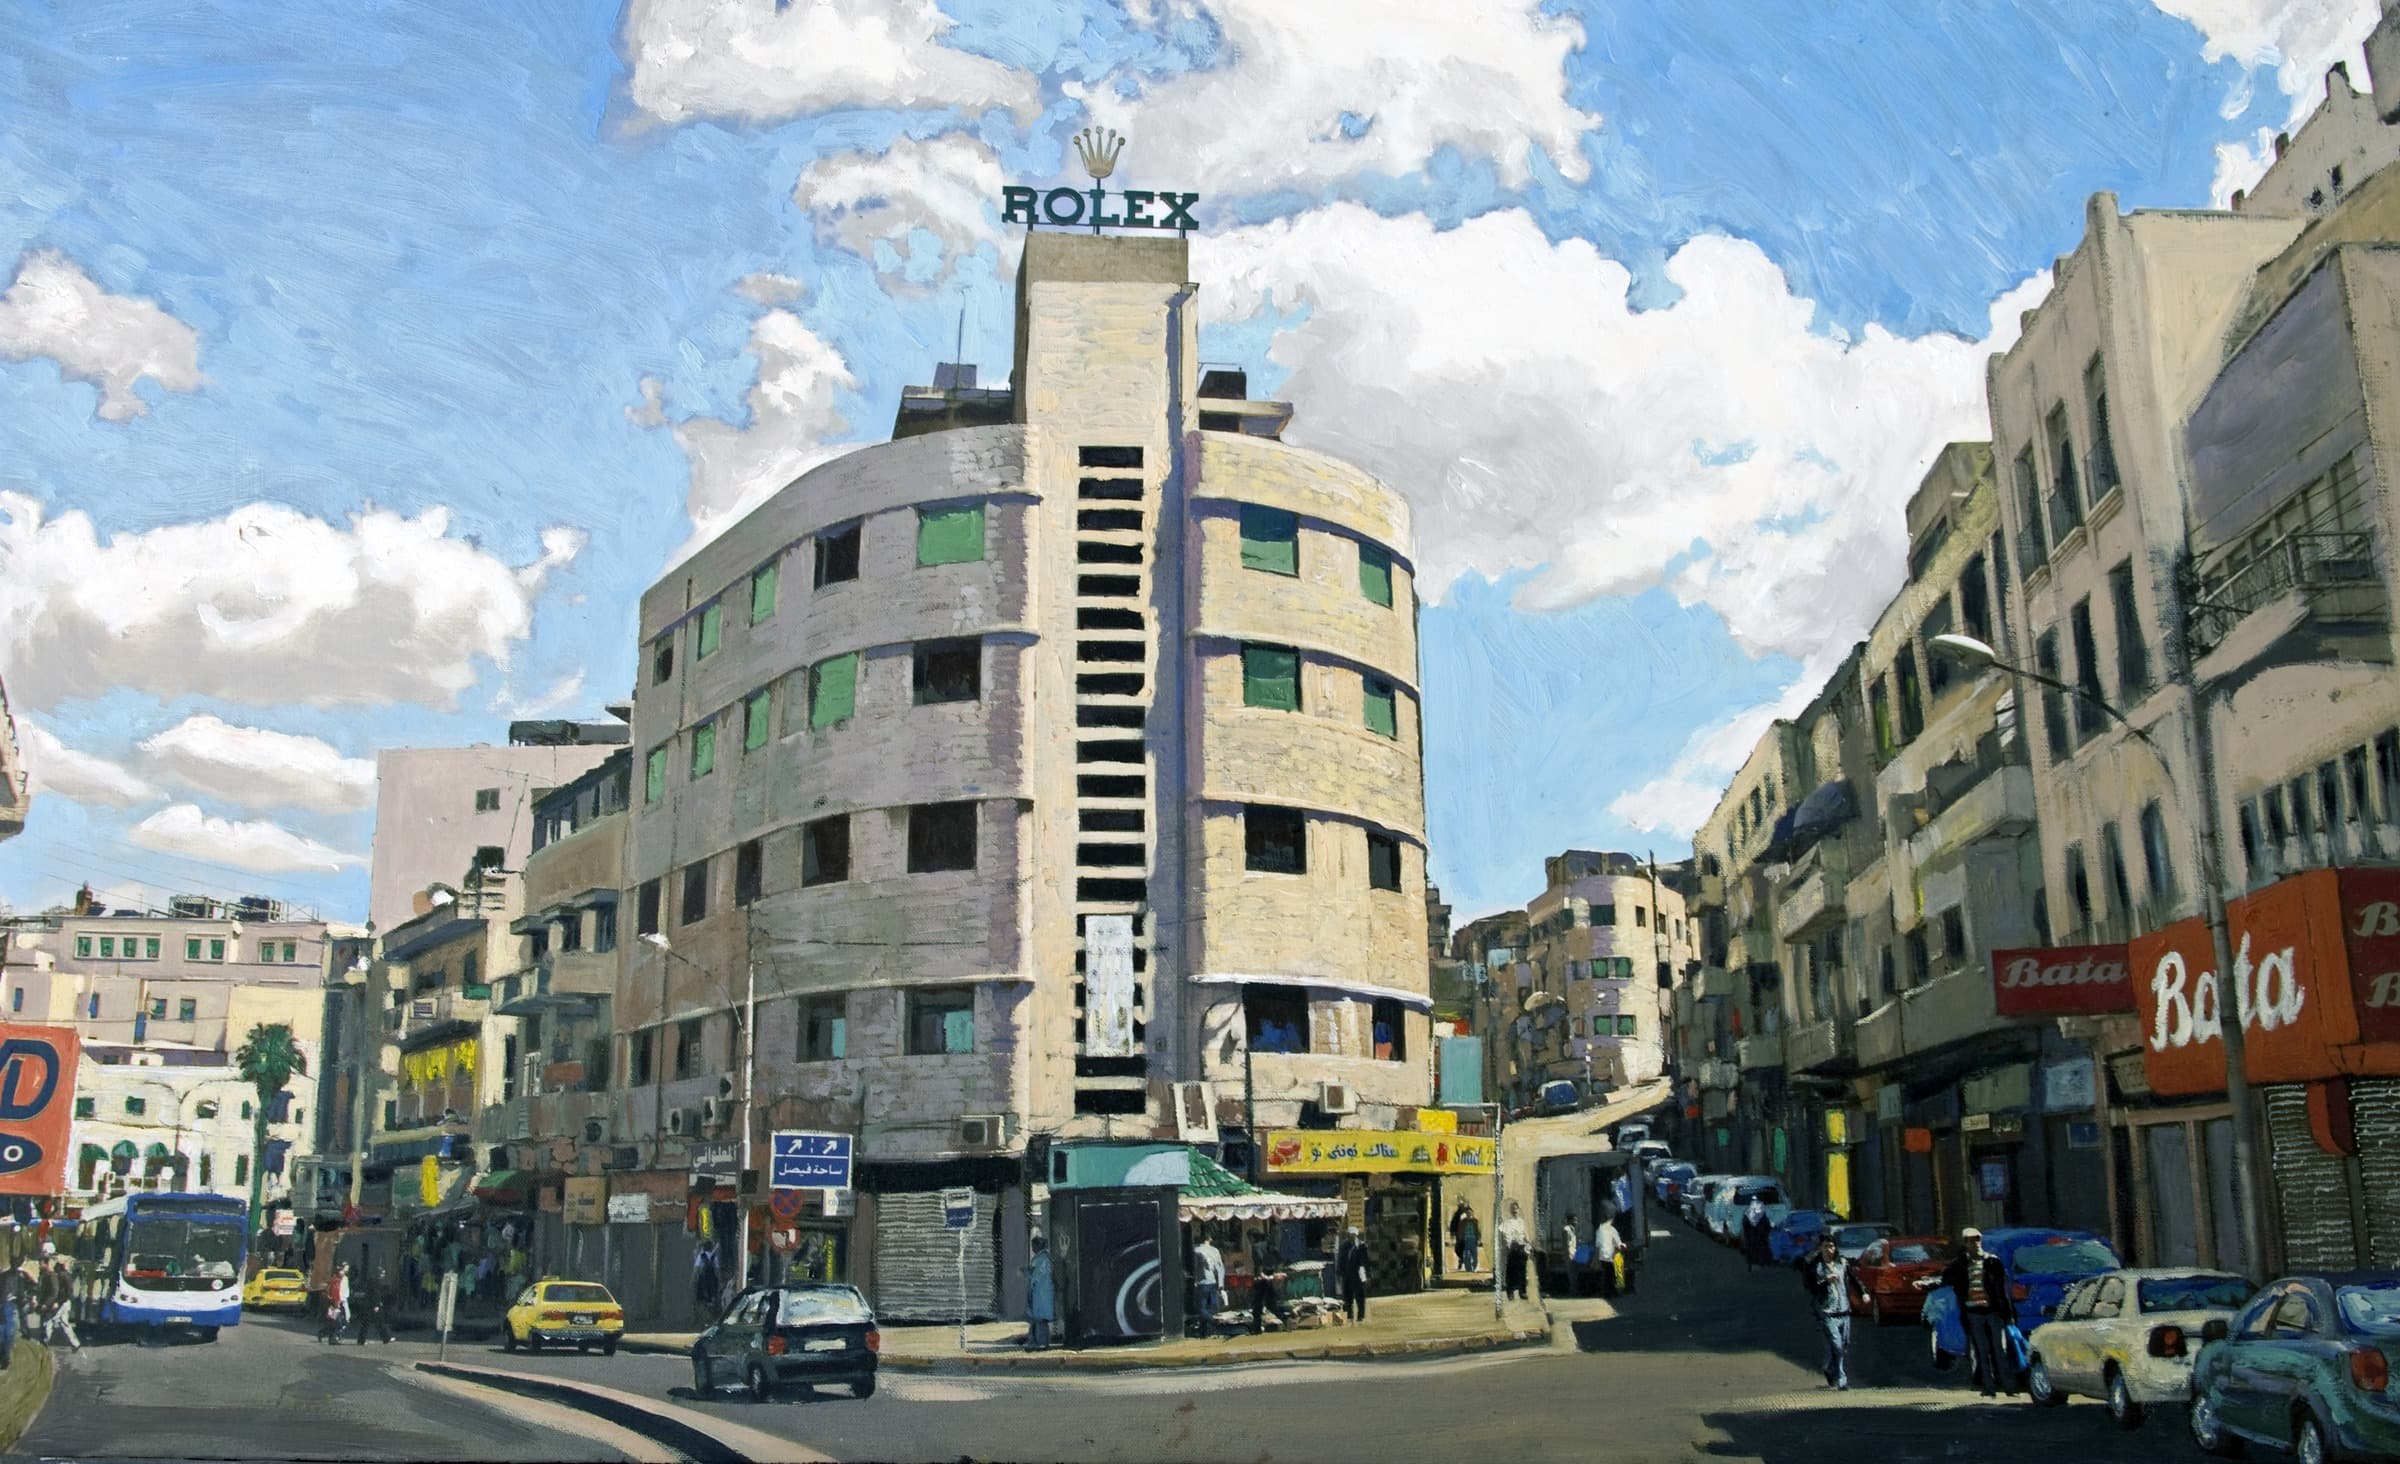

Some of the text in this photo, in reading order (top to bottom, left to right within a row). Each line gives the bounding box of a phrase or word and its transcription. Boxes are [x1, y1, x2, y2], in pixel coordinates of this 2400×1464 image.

[1002, 186, 1200, 230] ROLEX
[2001, 953, 2127, 988] Bata
[2151, 931, 2305, 1053] Bata
[778, 1163, 843, 1177] ساحة فيصل
